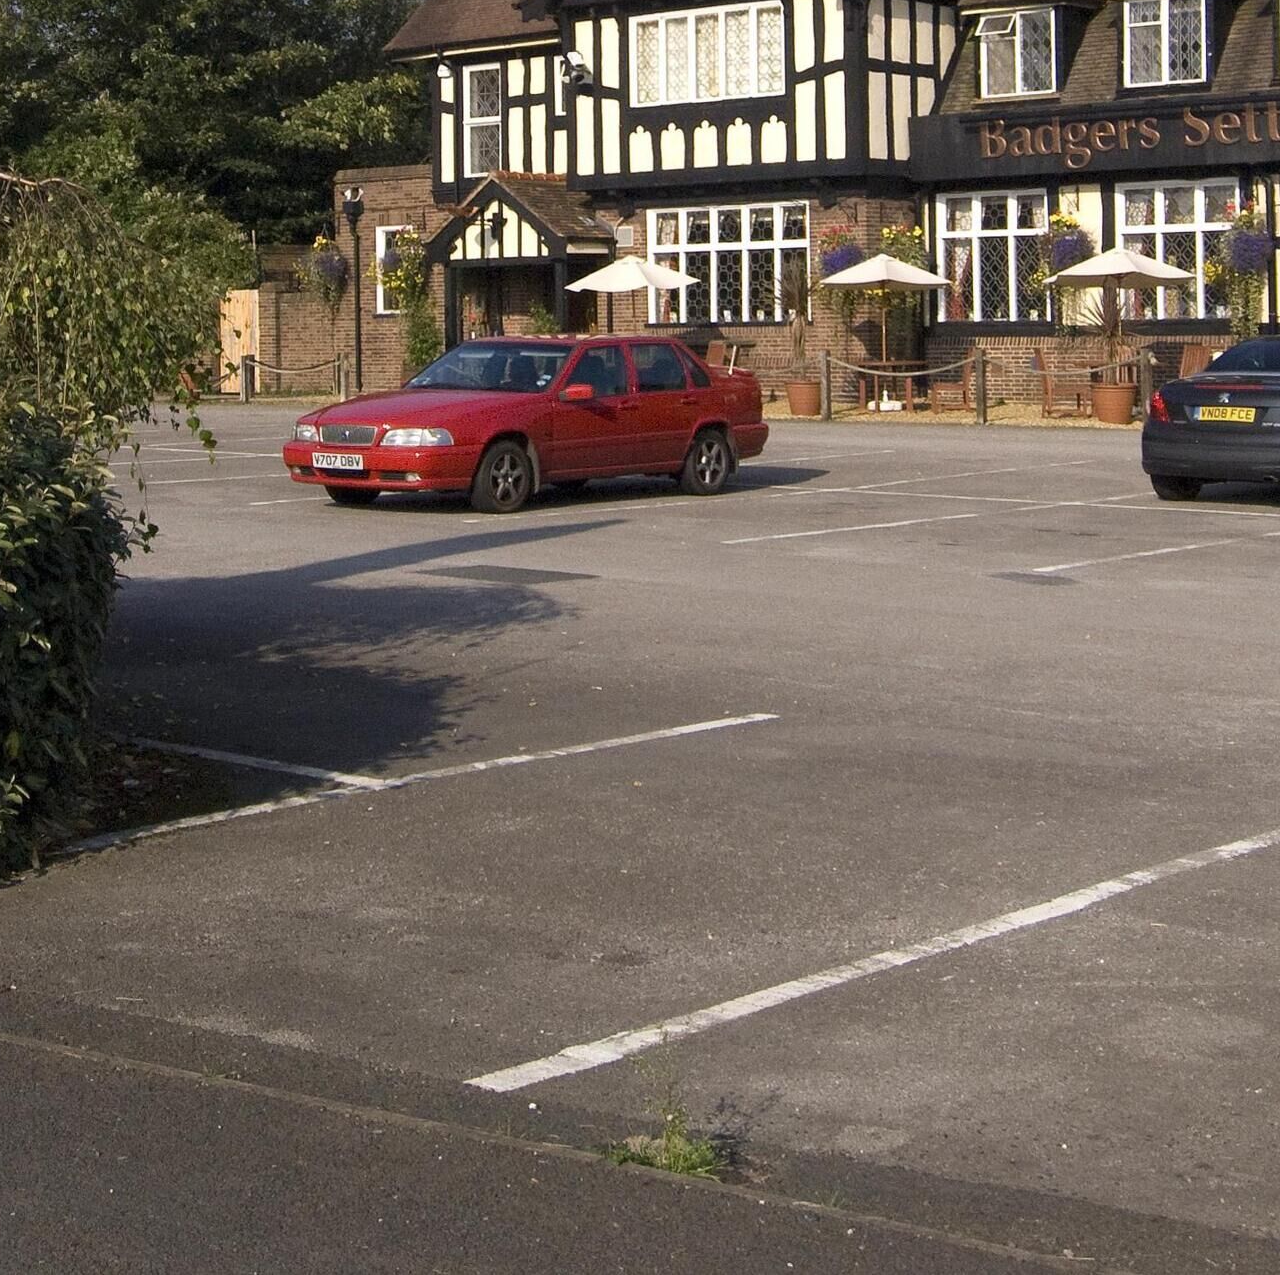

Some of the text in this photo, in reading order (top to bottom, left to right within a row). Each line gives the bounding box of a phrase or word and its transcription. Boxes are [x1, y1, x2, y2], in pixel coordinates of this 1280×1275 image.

[980, 116, 1160, 168] Badgers
[1200, 406, 1253, 420] VN08 FCE
[314, 454, 361, 467] V707 DBV
